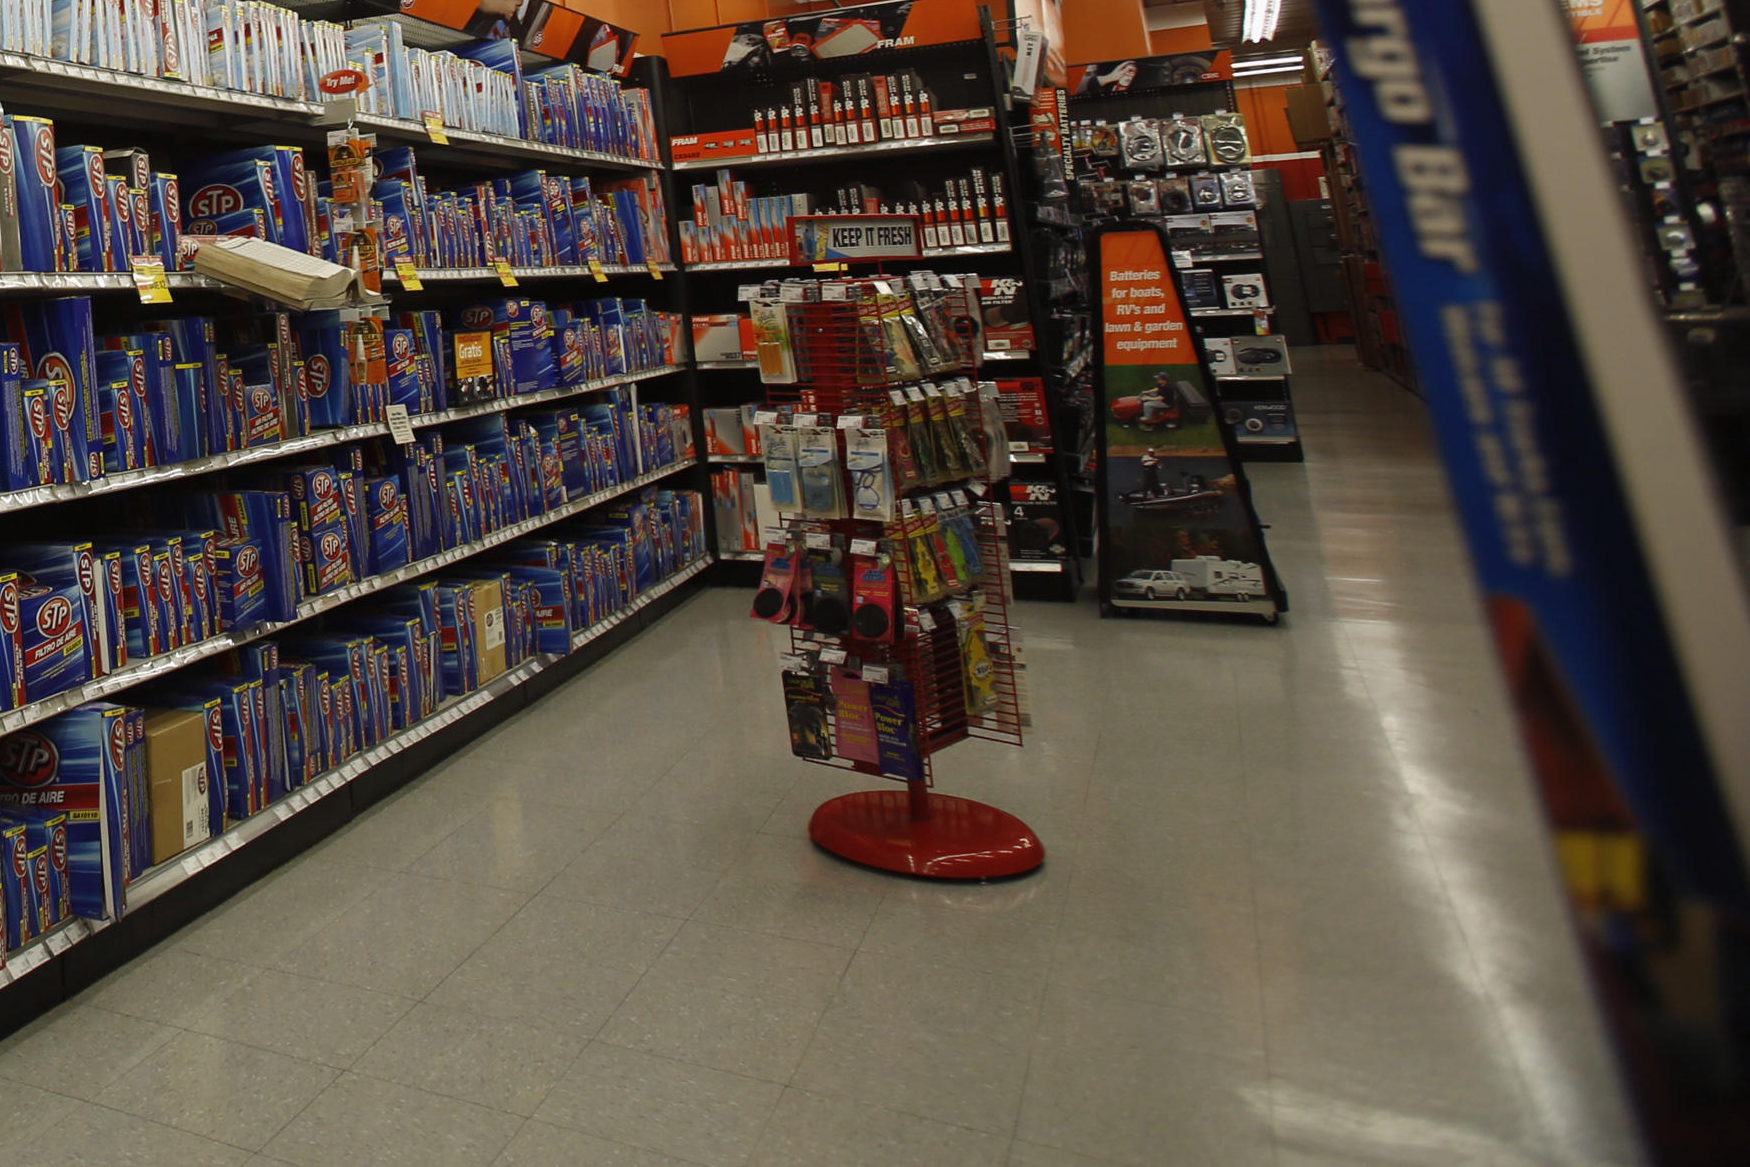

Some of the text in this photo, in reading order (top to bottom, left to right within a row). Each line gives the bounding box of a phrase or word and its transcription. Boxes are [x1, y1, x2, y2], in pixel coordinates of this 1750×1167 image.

[877, 36, 915, 48] FRAM
[326, 74, 356, 88] Try Me!
[671, 137, 698, 147] FRAM
[1056, 90, 1074, 180] SPECIALTY BATTERIES
[1391, 142, 1479, 275] Bar
[832, 226, 912, 248] KEEP IT FRESH
[1110, 269, 1161, 281] Batteries
[1112, 286, 1164, 298] for boats,
[1116, 303, 1165, 315] RV's and
[1105, 320, 1183, 334] lawn & garden
[459, 342, 482, 358] Gratis
[1116, 338, 1178, 350] equipment
[35, 628, 76, 659] FILTRO DE AIRE
[22, 790, 64, 804] DE AIRE
